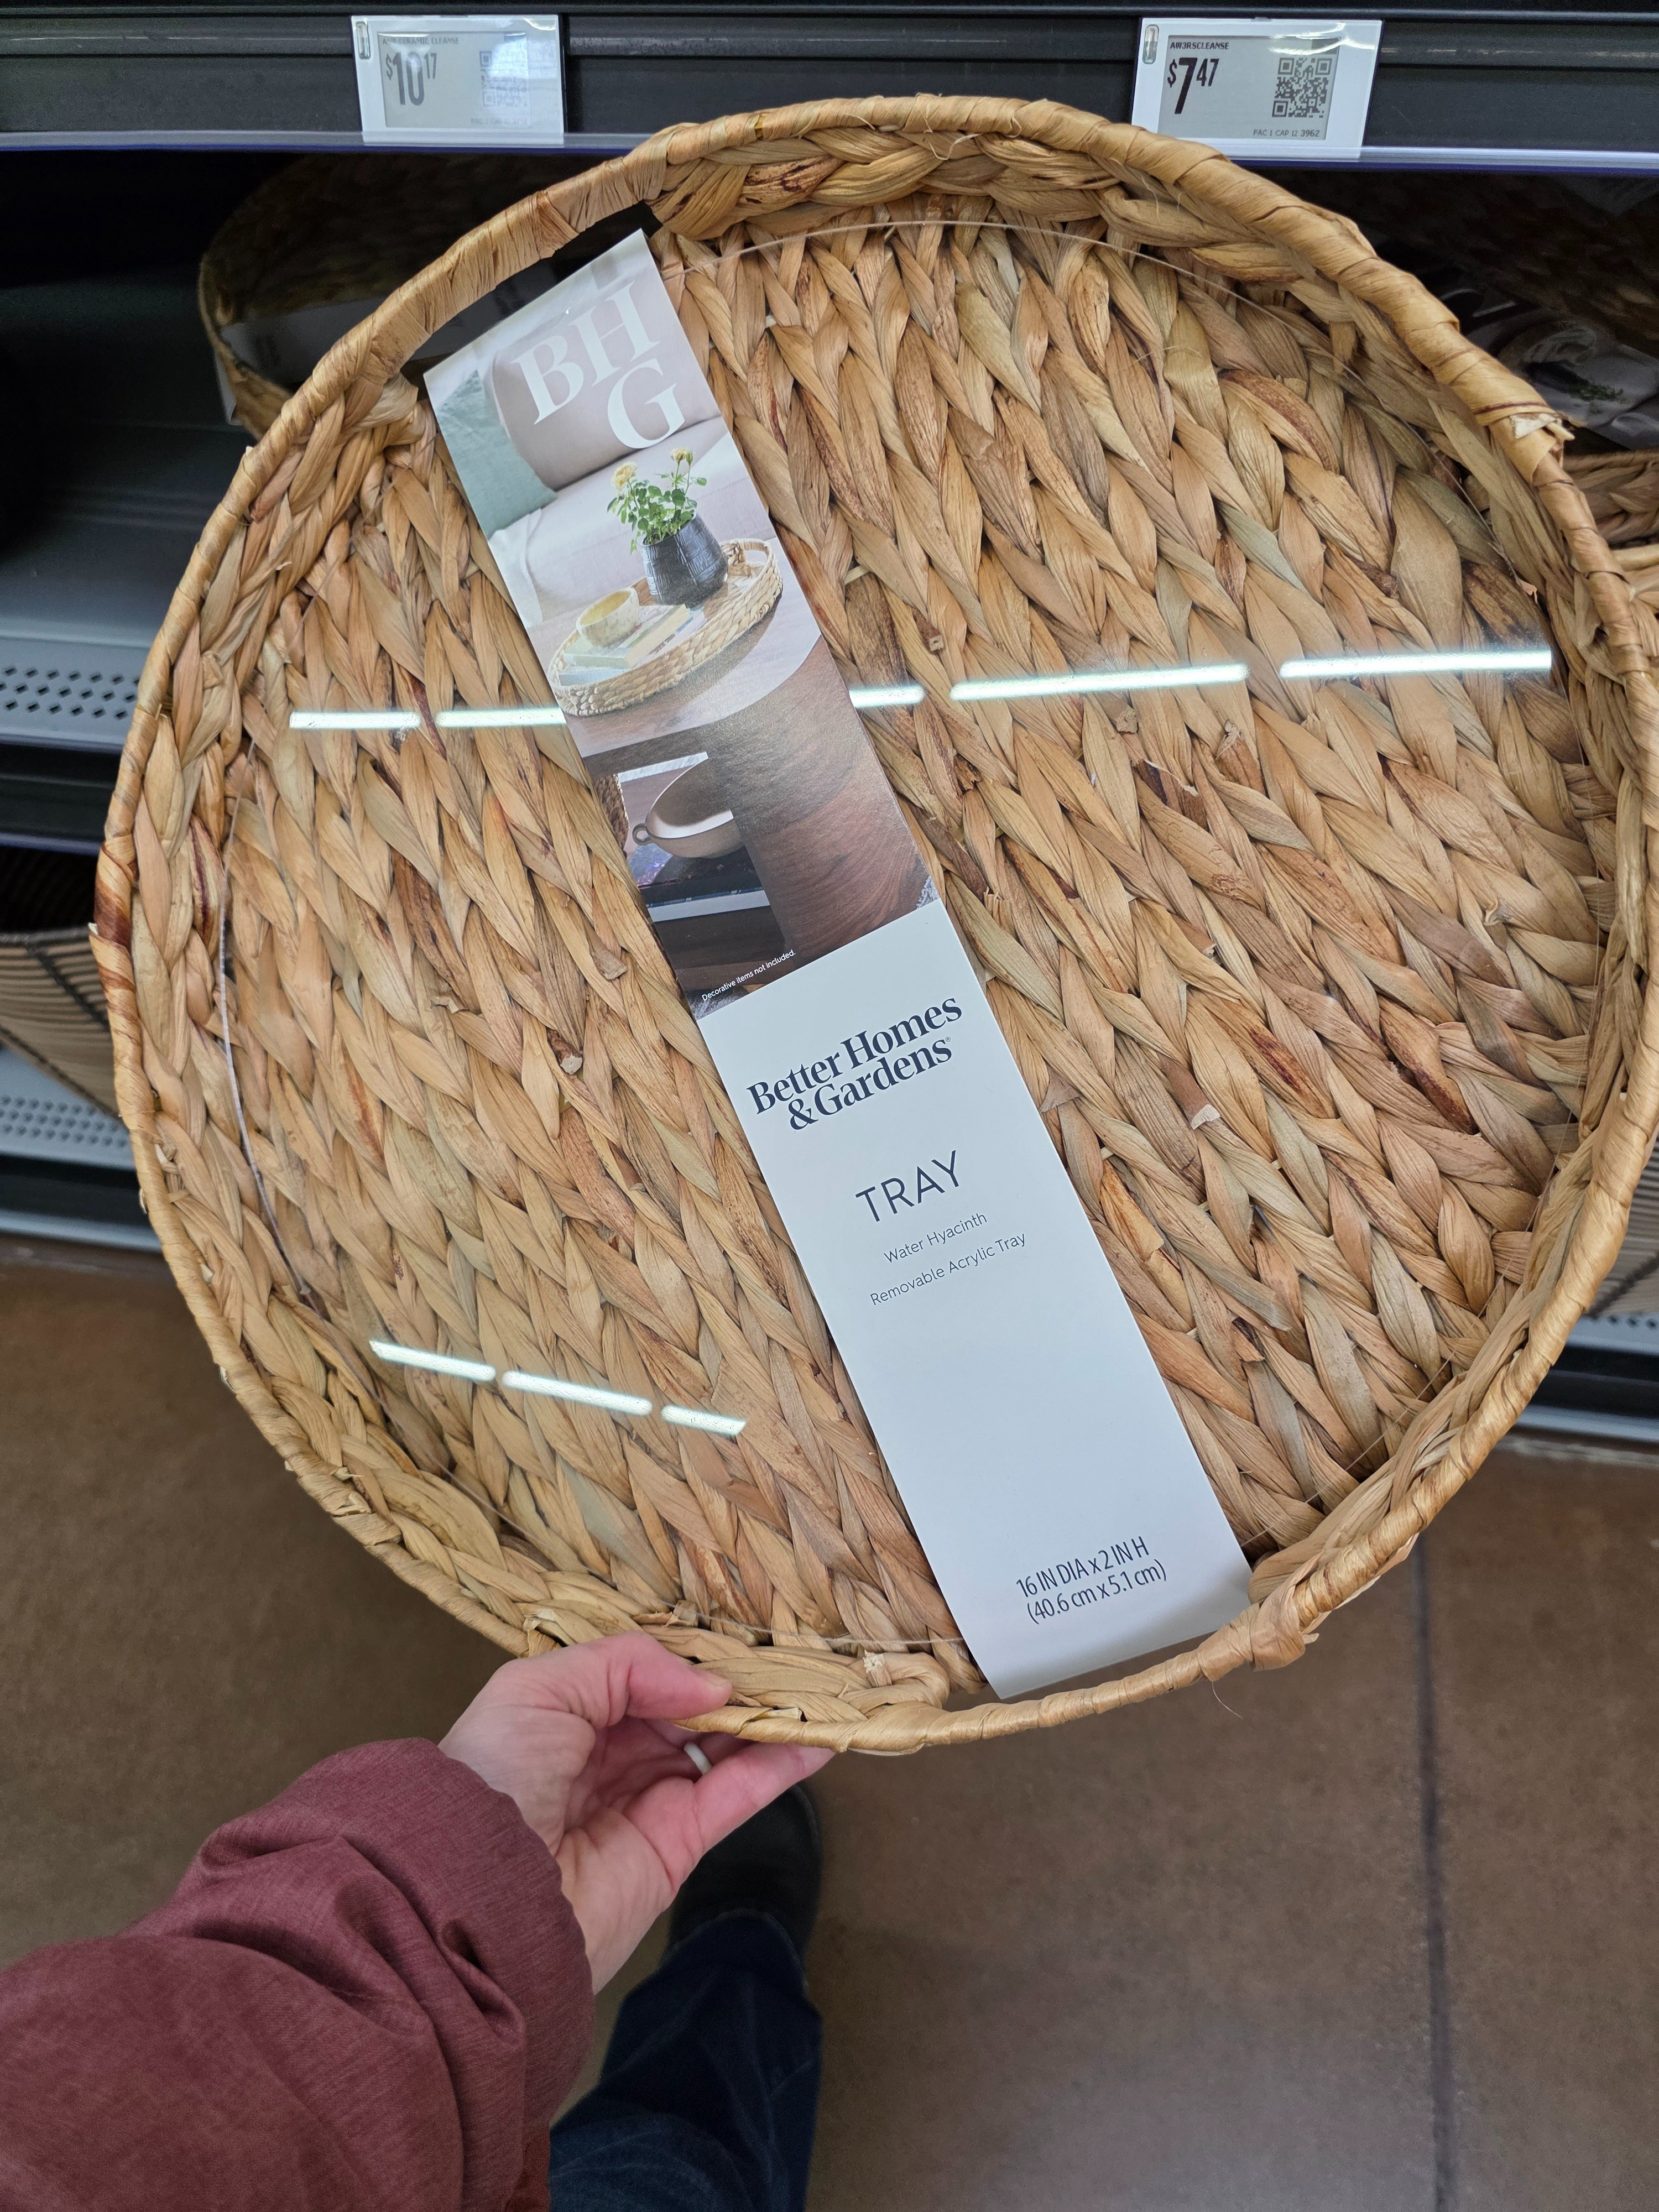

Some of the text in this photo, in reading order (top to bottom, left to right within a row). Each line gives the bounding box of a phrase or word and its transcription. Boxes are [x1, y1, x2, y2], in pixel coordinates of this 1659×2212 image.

[510, 281, 660, 425] BH
[607, 358, 685, 449] G
[701, 949, 796, 1001] Decorative items not included.
[746, 998, 962, 1115] Better Homes
[855, 1150, 959, 1222] TRAY
[870, 1233, 1025, 1306] Removable Acrylic Tray
[884, 1213, 987, 1263] Water Hyacinth
[1016, 1536, 1149, 1598] 16 IN DIA x 2 IN H
[1026, 1558, 1166, 1625] (40.6 cm x 5.1 cm)
